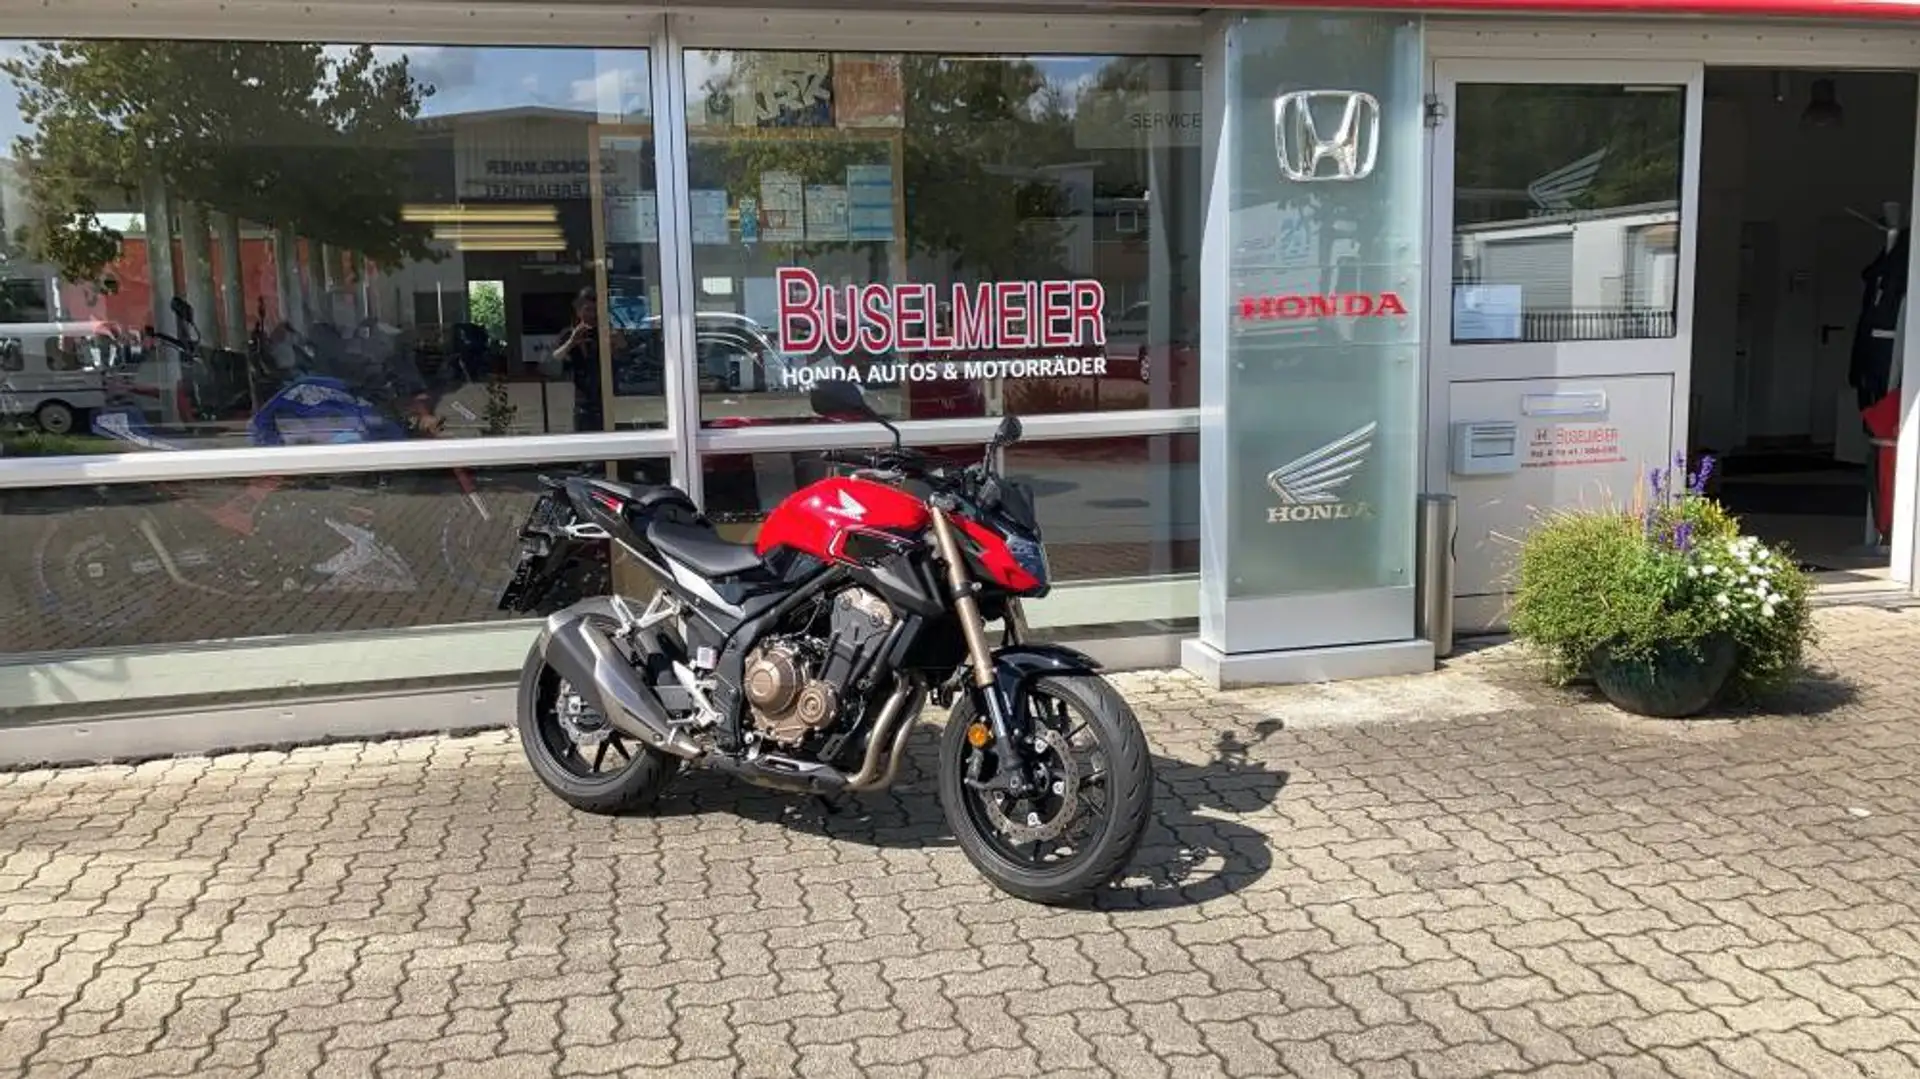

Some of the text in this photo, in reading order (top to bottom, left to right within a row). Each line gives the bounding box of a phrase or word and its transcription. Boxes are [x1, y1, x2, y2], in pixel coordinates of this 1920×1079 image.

[1131, 112, 1202, 128] SERVICE
[776, 266, 1106, 355] BUSELMEIER
[1239, 292, 1408, 319] HONDA
[782, 355, 1107, 388] HONDA AUTOS & MOTORRÄDER
